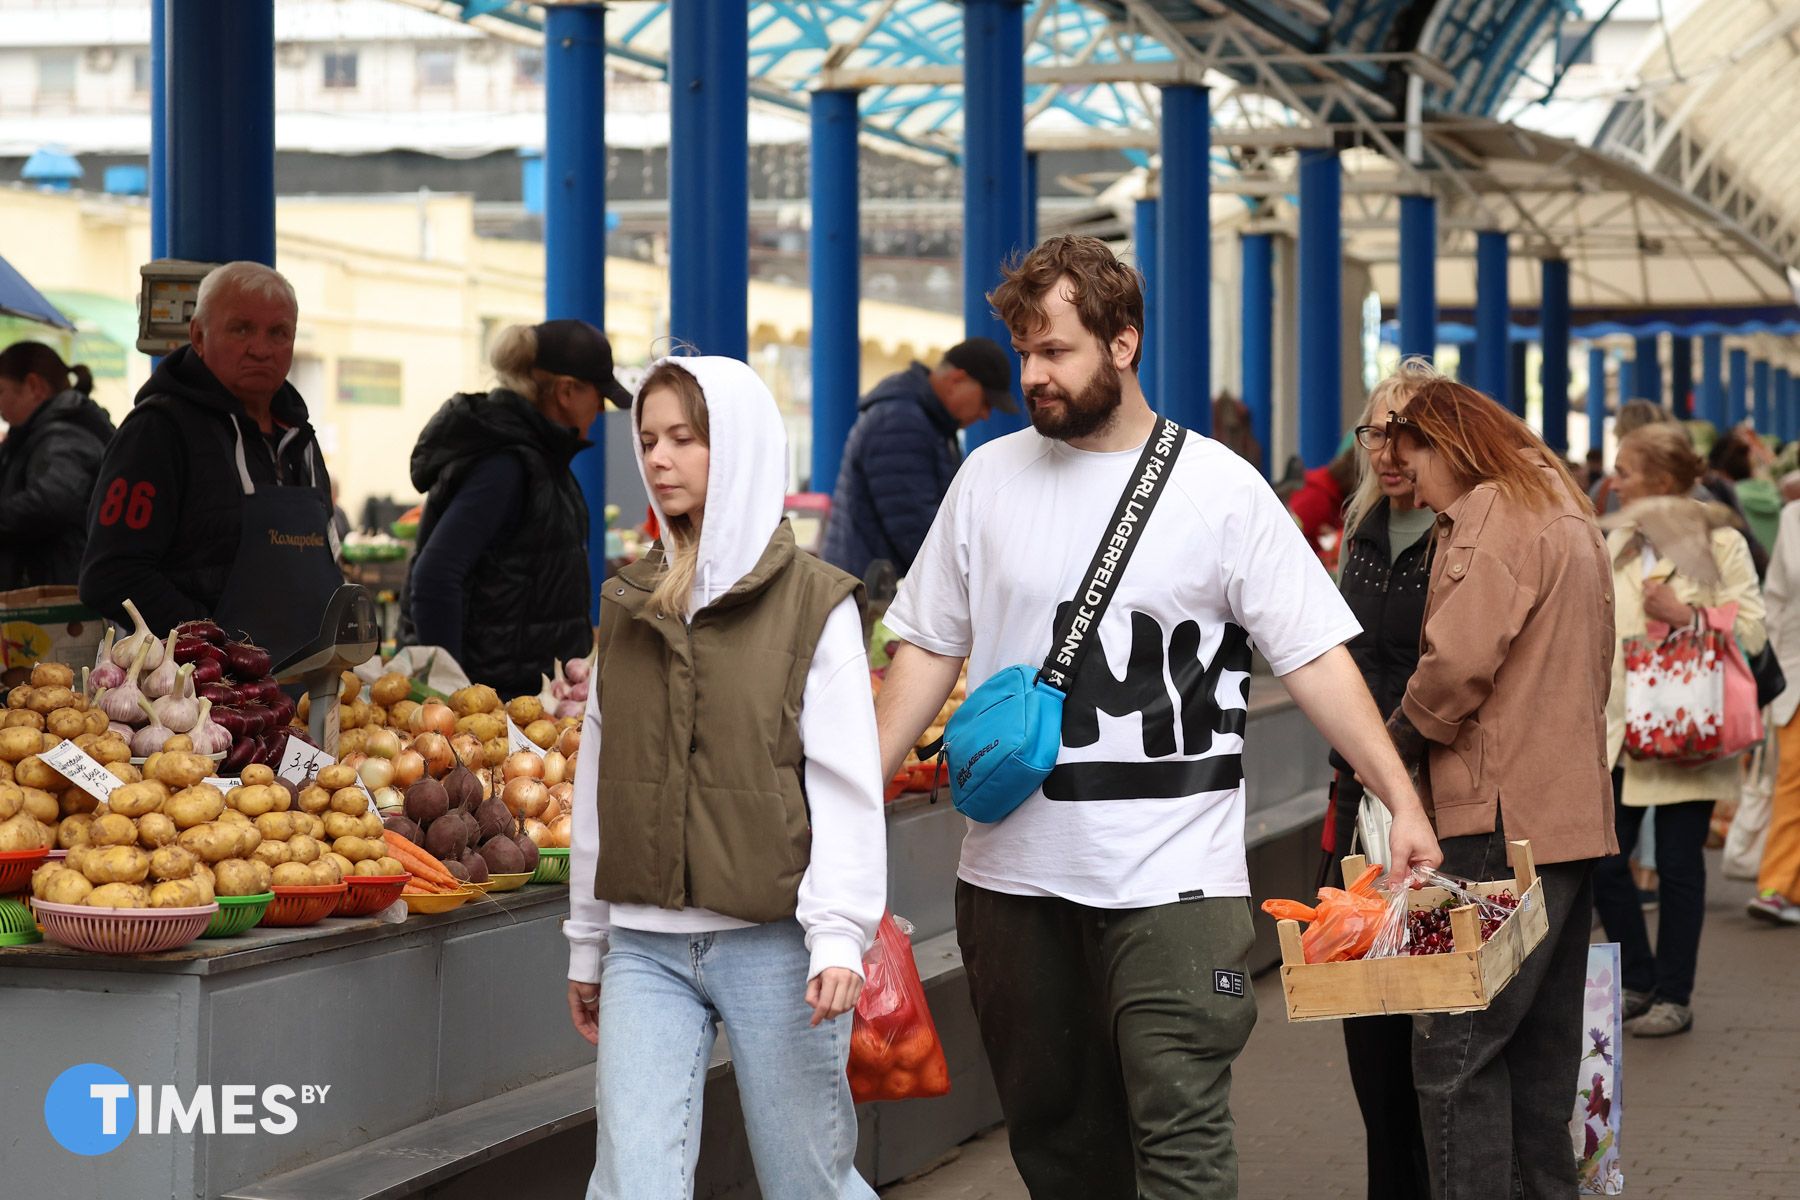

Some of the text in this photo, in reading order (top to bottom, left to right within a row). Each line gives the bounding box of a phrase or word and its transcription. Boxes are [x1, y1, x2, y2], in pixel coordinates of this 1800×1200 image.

[1155, 418, 1180, 457] EANS
[99, 477, 156, 530] 86
[1131, 455, 1165, 499] KARL
[1084, 500, 1144, 607] LAGERFELD
[1056, 605, 1096, 667] JEANS
